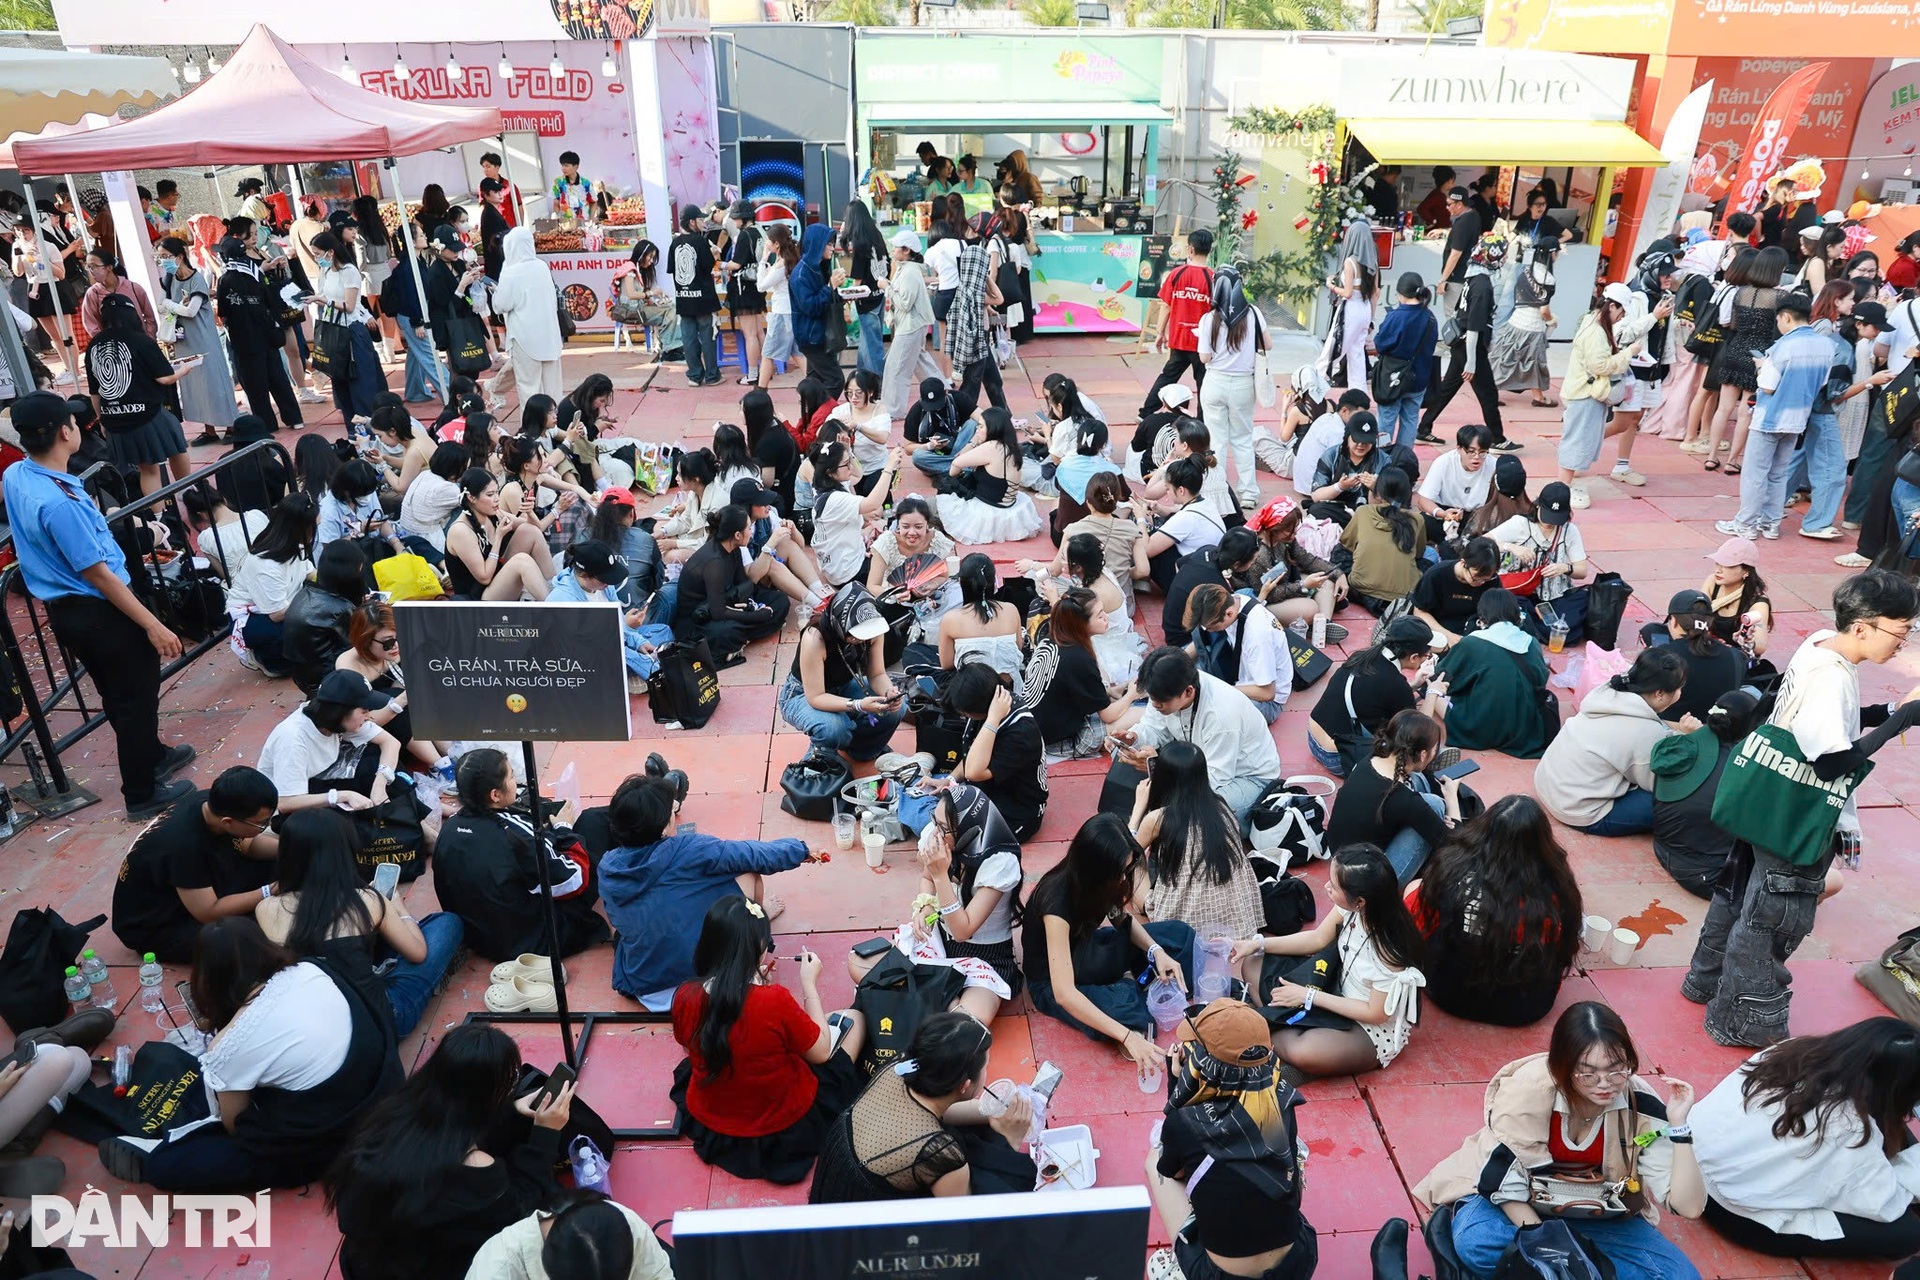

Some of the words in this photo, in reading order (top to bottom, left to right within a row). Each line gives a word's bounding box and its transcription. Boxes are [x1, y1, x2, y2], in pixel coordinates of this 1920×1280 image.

[1784, 0, 1814, 14] Danh
[360, 67, 492, 100] SAKURA
[507, 67, 594, 101] FOOD
[1389, 66, 1580, 104] zumwhere
[1718, 88, 1749, 104] Rán
[1811, 91, 1843, 105] anh
[541, 113, 562, 132] PHỐ
[1883, 111, 1911, 130] KEM
[577, 259, 602, 271] ANH
[428, 657, 455, 672] GÀ
[458, 656, 502, 673] RÁN,
[504, 656, 542, 672] TRÀ
[545, 657, 596, 673] SỮA...
[441, 675, 457, 687] GÌ
[460, 676, 503, 688] CHƯA
[505, 674, 553, 688] NGƯỜI
[556, 677, 586, 690] ĐẸP
[1733, 755, 1748, 768] EST
[1826, 794, 1844, 810] 1976
[151, 1079, 175, 1108] CONCERT
